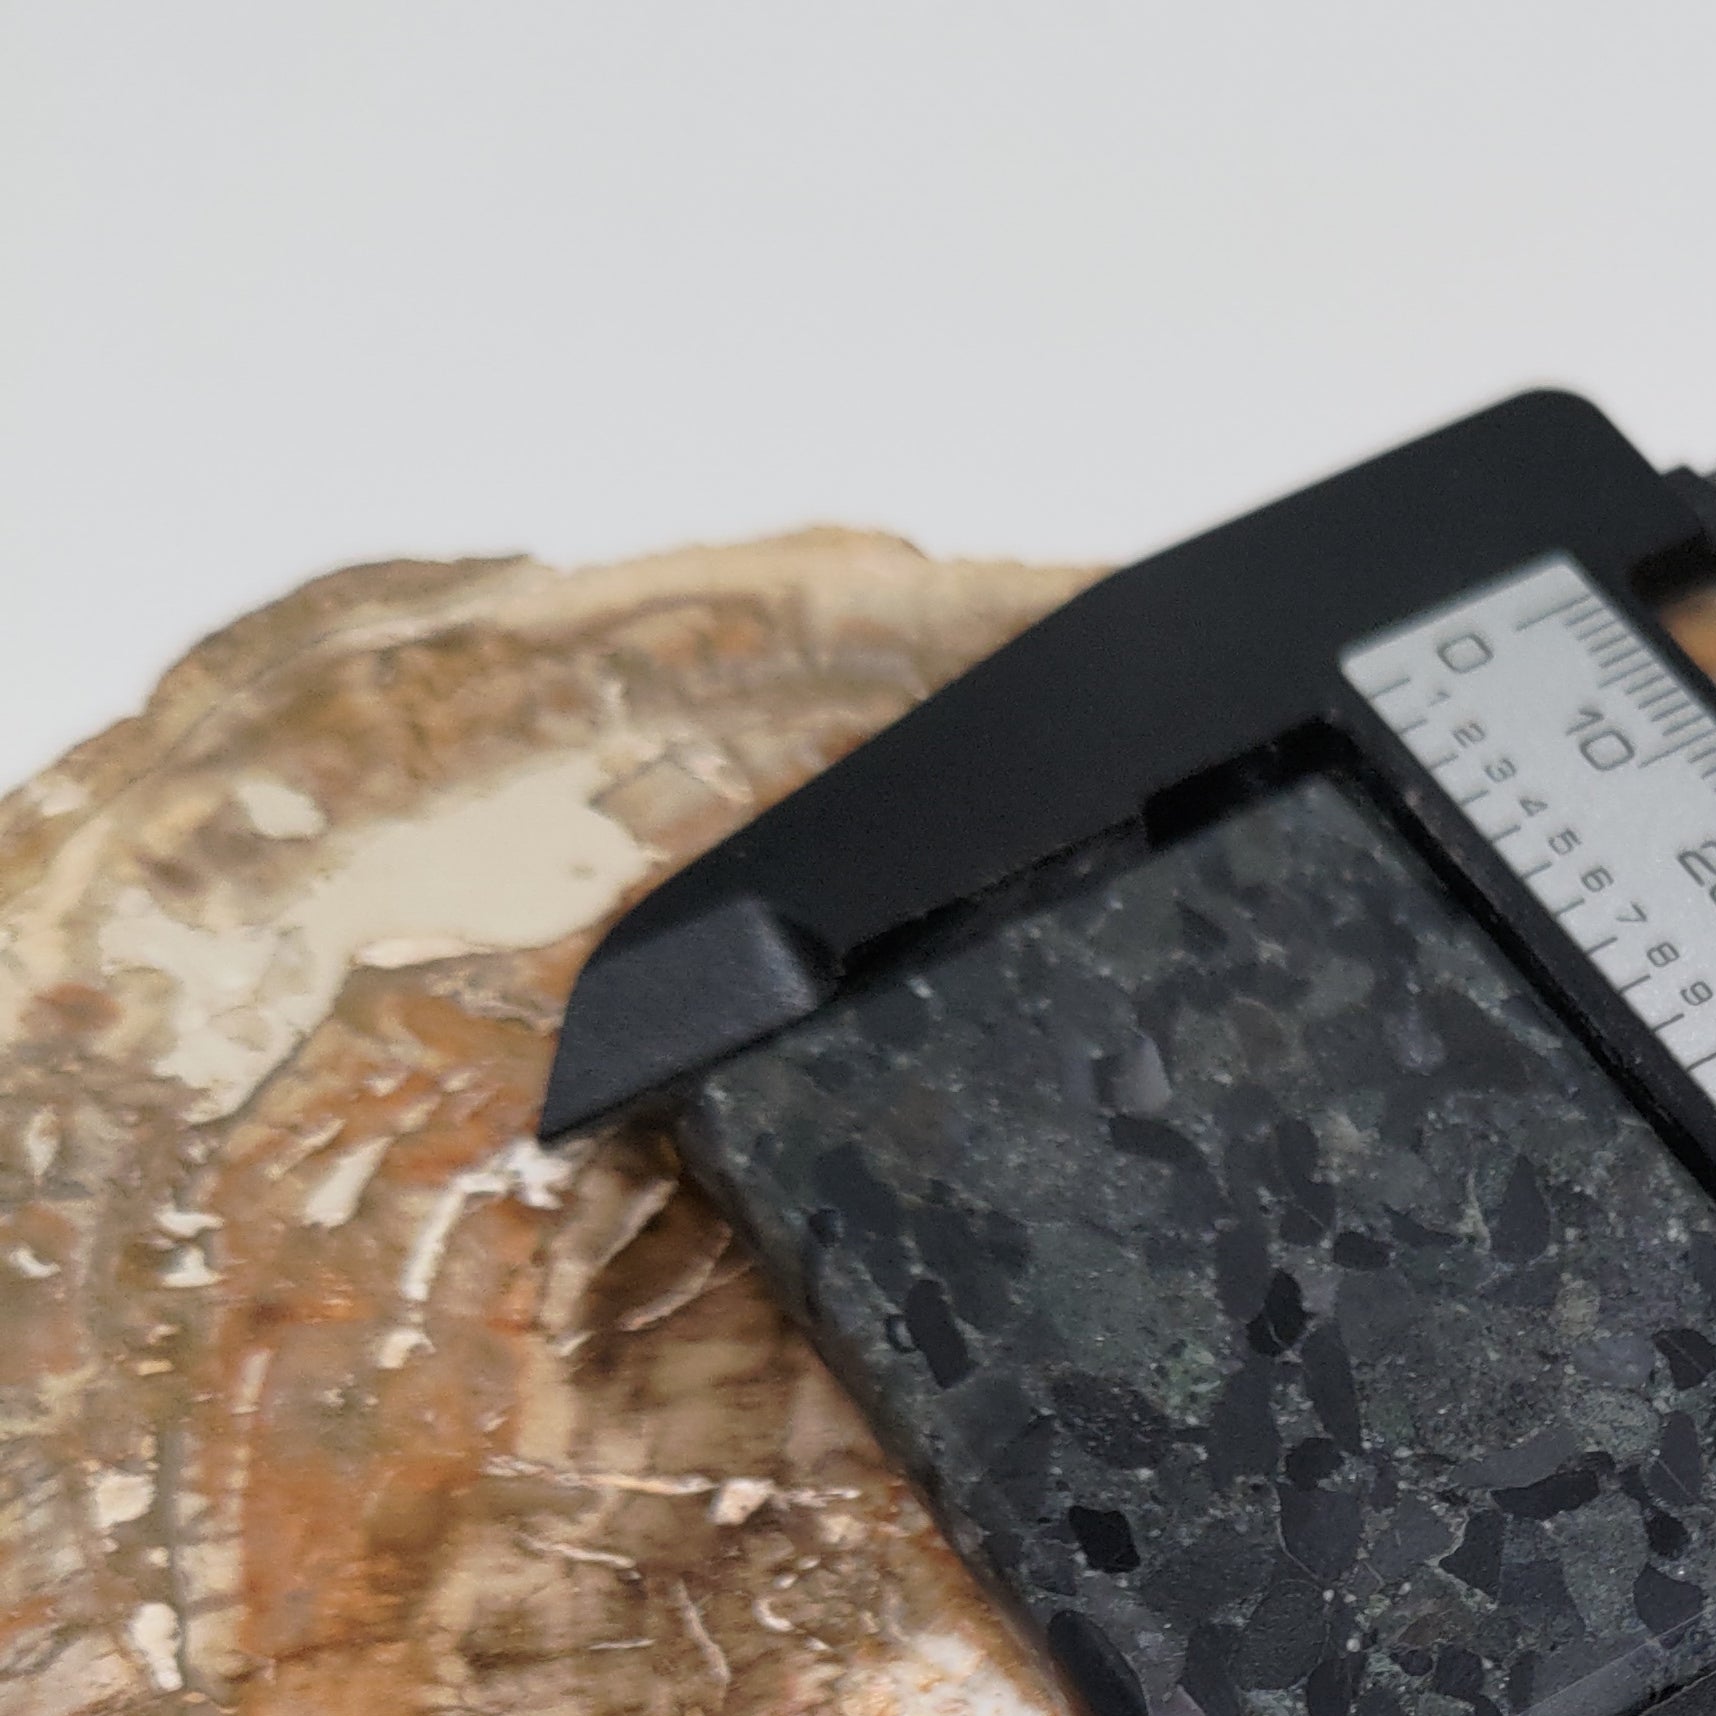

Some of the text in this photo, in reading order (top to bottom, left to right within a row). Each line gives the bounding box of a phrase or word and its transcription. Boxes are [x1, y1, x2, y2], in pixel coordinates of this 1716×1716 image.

[1437, 633, 1493, 674] 0
[1566, 706, 1635, 771] 10
[1428, 689, 1452, 707] 1
[1452, 722, 1486, 748] 2
[1484, 758, 1516, 782] 3
[1519, 796, 1548, 817] 4
[1548, 828, 1581, 855] 5
[1581, 865, 1614, 892] 6
[1616, 902, 1648, 925] 7
[1646, 941, 1680, 968] 8
[1680, 981, 1713, 1006] 9
